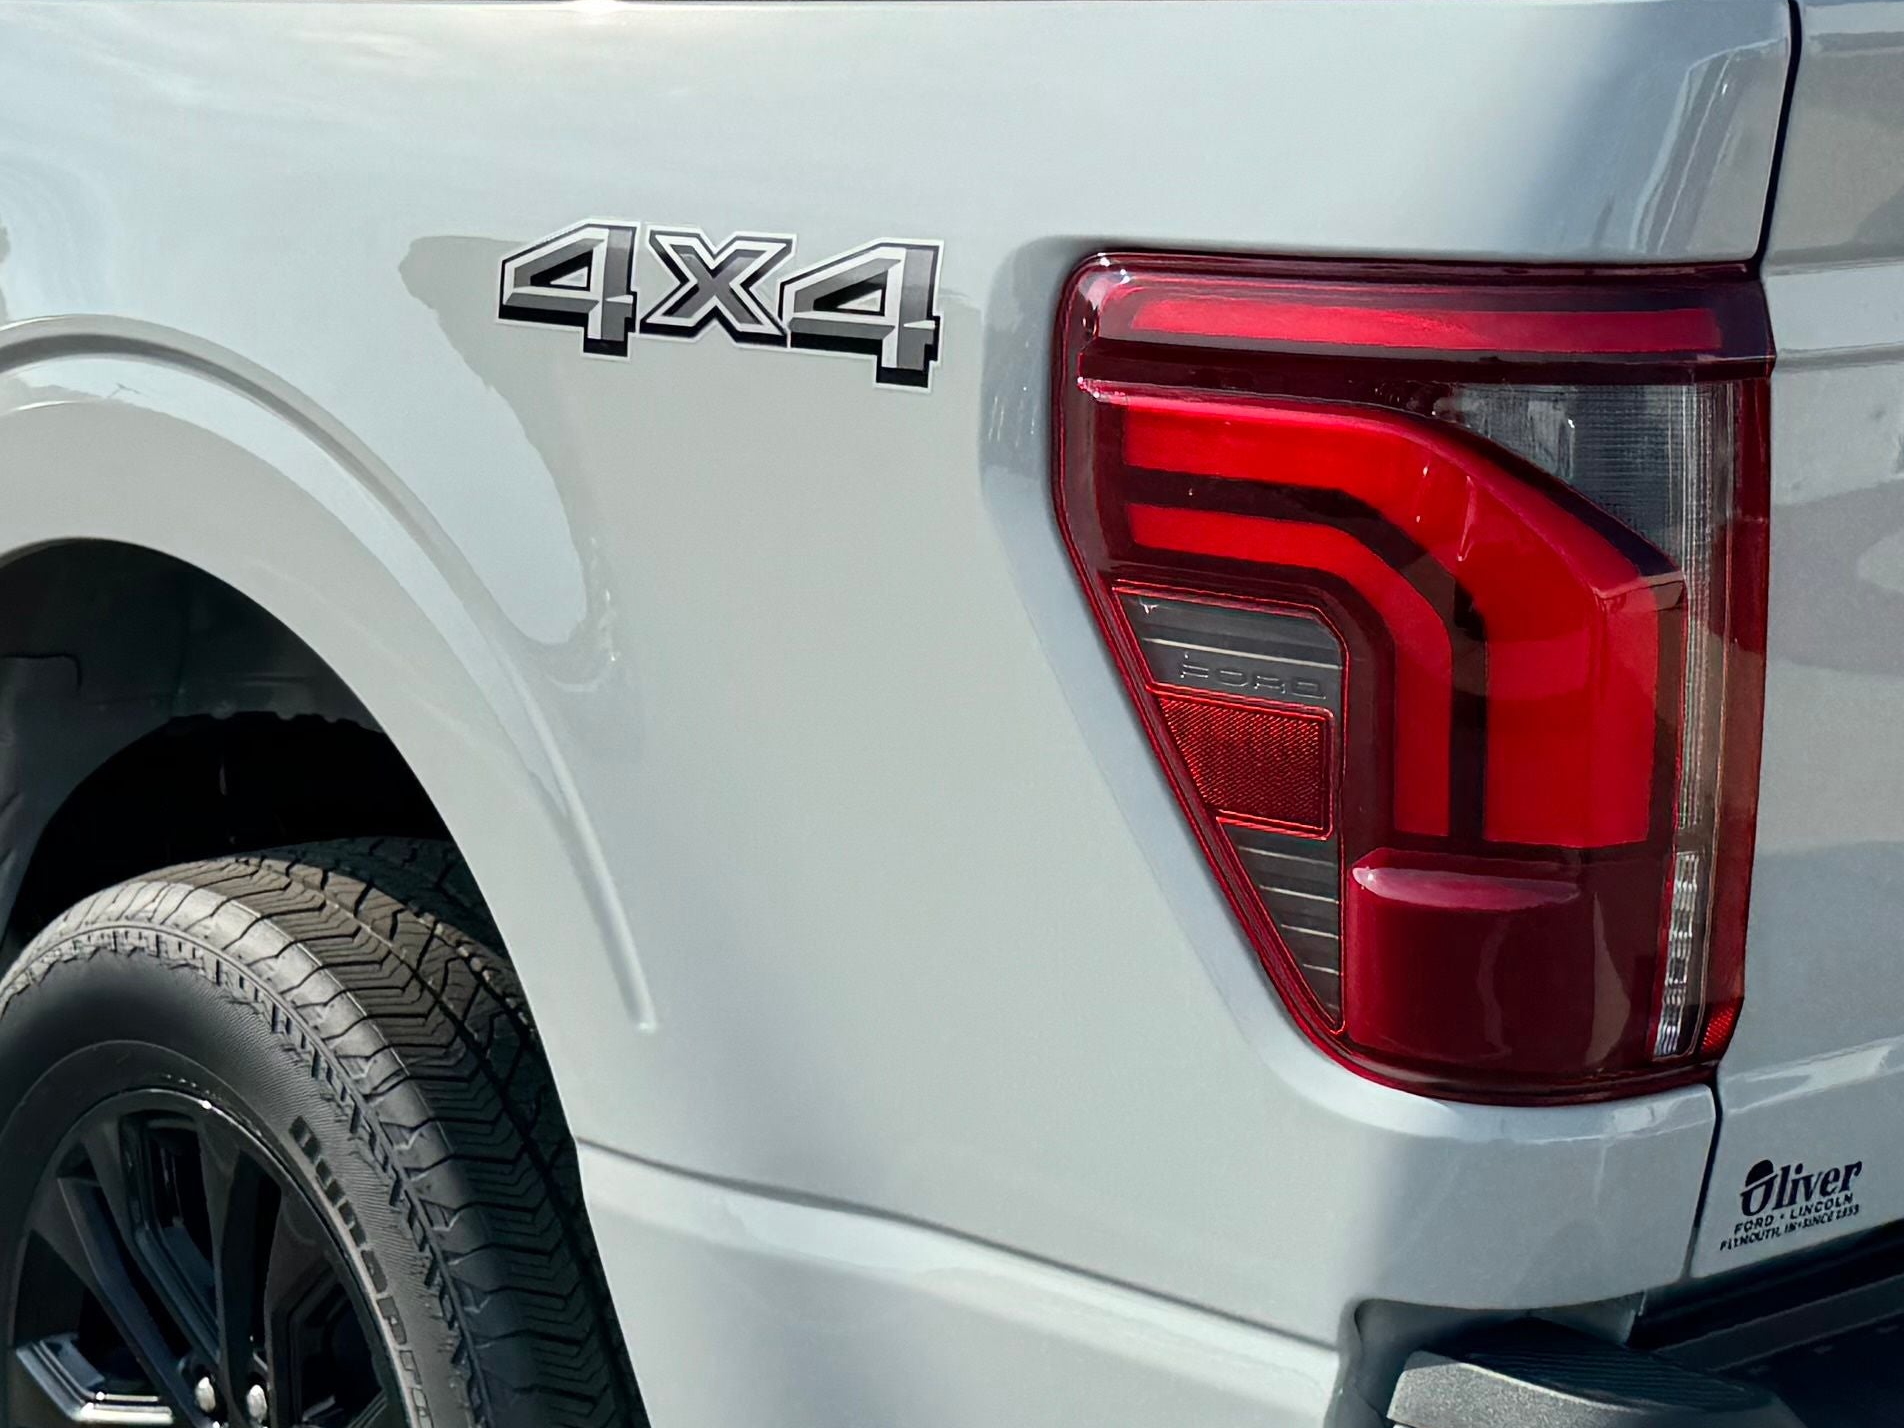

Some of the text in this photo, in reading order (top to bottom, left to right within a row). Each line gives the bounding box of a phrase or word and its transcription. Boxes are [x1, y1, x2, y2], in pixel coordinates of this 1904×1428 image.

[1179, 652, 1327, 700] FORD
[1739, 1159, 1863, 1217] Oliver
[1733, 1192, 1854, 1235] FORD LINCOLN
